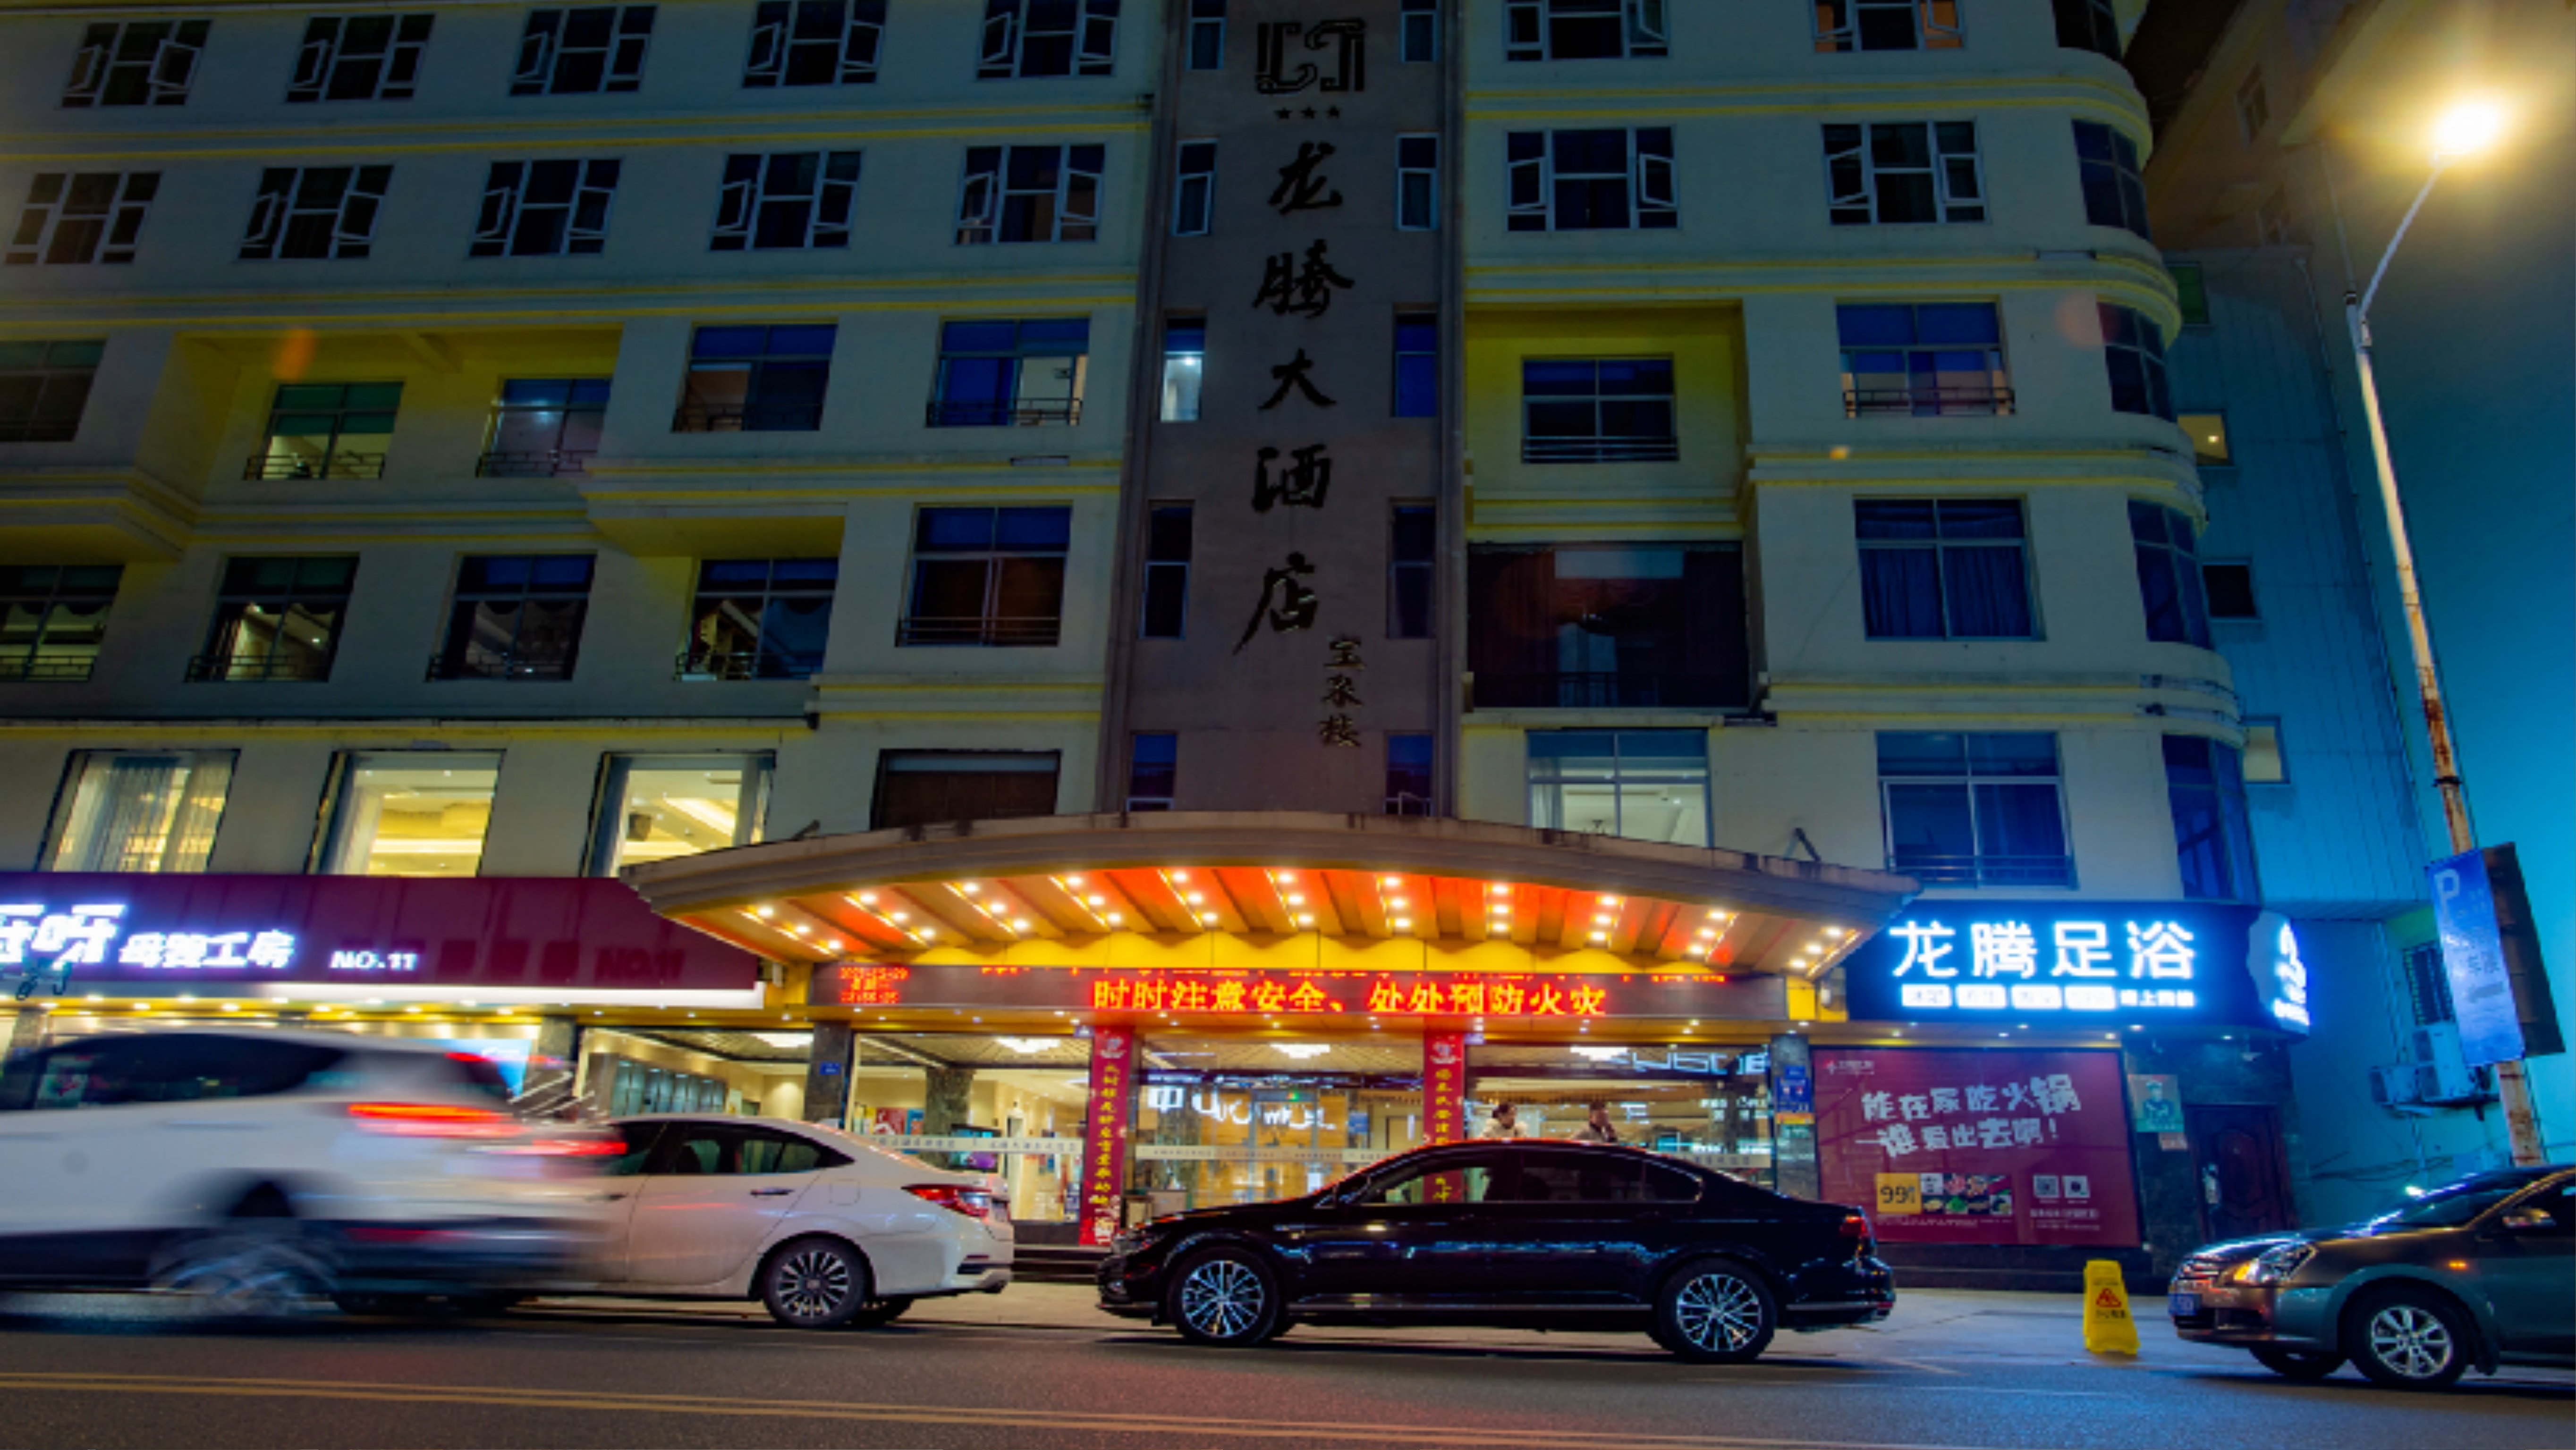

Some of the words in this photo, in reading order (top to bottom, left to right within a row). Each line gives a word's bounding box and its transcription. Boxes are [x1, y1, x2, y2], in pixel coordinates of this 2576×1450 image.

[1233, 141, 1355, 656] 龙腾大酒店
[2434, 868, 2460, 923] P
[330, 950, 415, 970] NO.11
[1889, 920, 2195, 979] 龙腾足浴
[1094, 978, 1606, 1015] 时时注意安全、处处预防火灾
